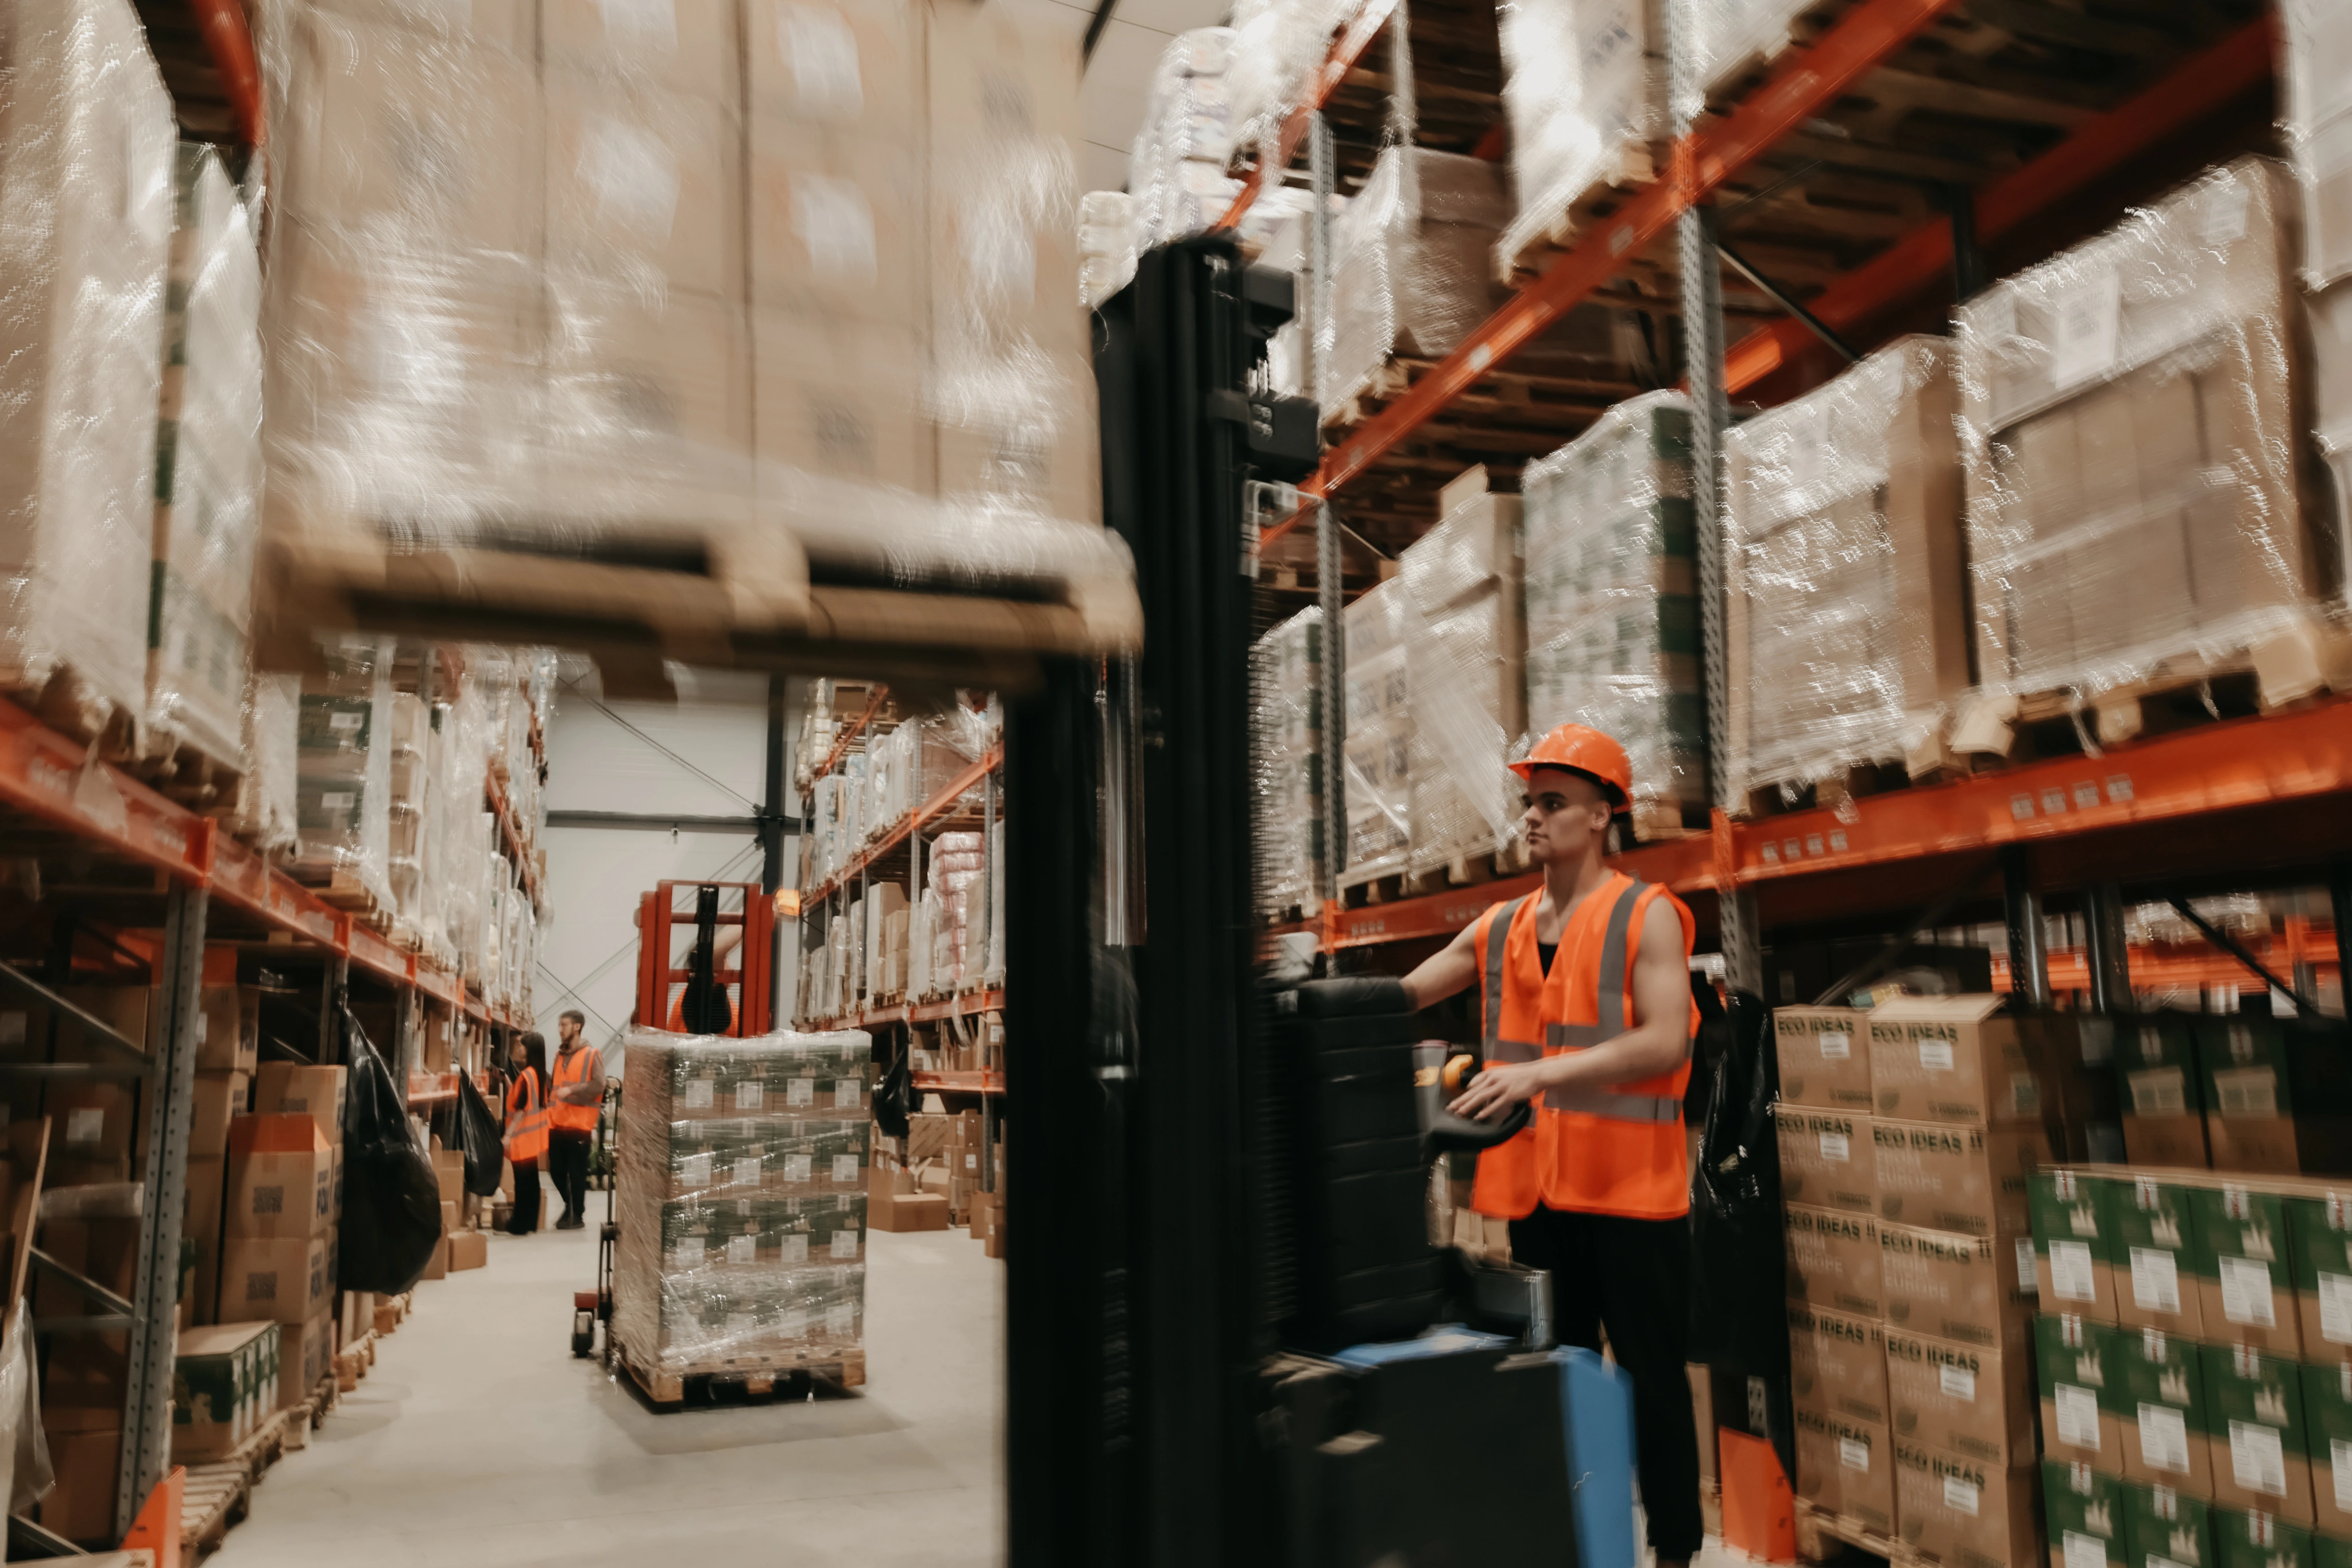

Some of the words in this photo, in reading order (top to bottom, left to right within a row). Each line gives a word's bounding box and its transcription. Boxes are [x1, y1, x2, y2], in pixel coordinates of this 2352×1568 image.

[1777, 1016, 1805, 1035] ECO
[1810, 1017, 1855, 1037] IDEAS
[1871, 1023, 1902, 1044] ECO
[1906, 1023, 1959, 1047] IDEAS
[1777, 1113, 1805, 1133] ECO
[1809, 1115, 1854, 1139] IDEAS
[1873, 1126, 1905, 1148] ECO
[1910, 1129, 1963, 1155] IDEAS
[1877, 1168, 1943, 1195] EUROPE
[1786, 1210, 1812, 1232] ECO
[1817, 1214, 1860, 1241] IDEAS
[1881, 1229, 1913, 1254] ECO
[1918, 1237, 1971, 1265] IDEAS
[1885, 1272, 1950, 1304] EUROPE
[1820, 1315, 1864, 1344] IDEAS
[1888, 1335, 1921, 1362] ECO
[1927, 1345, 1980, 1377] IDEAS
[1828, 1419, 1872, 1450] IDEAS
[1897, 1443, 1928, 1472] ECO
[1933, 1454, 1985, 1492] IDEAS
